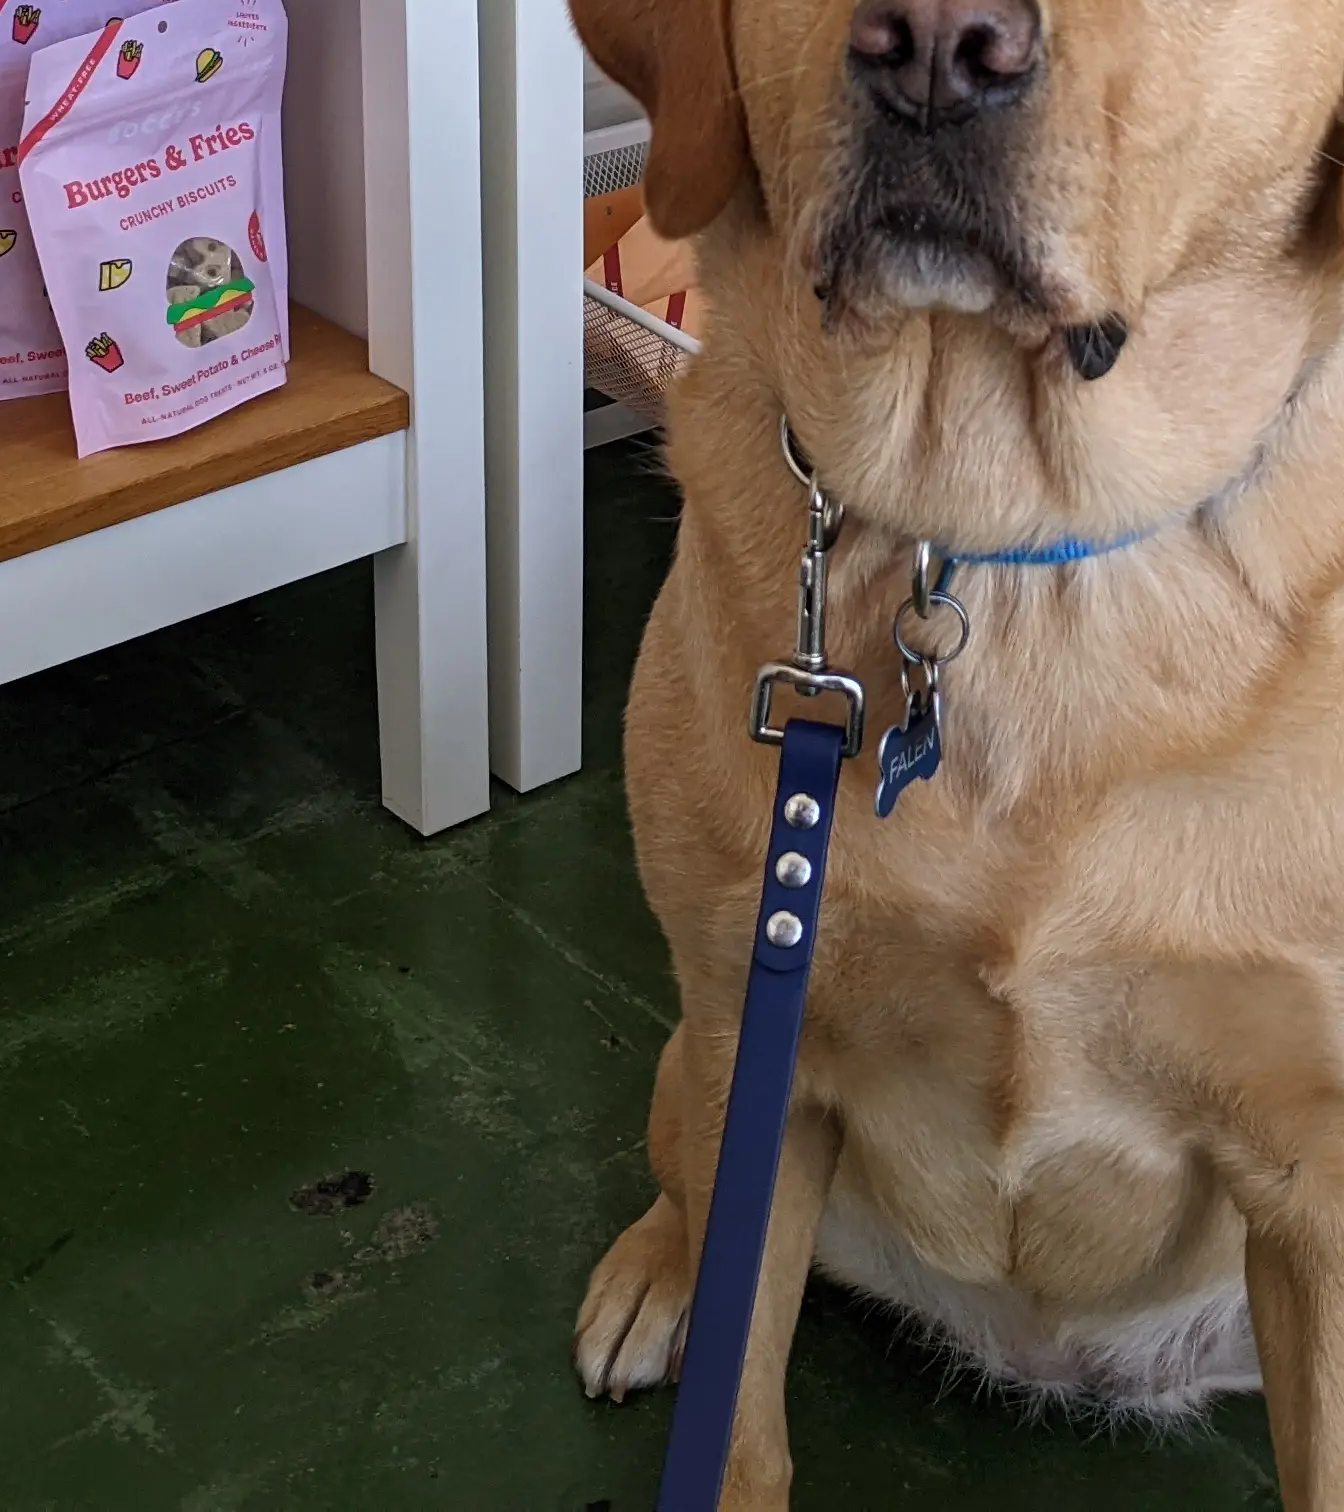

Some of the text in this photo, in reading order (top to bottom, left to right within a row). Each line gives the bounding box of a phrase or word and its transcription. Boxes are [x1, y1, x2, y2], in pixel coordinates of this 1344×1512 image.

[63, 122, 254, 209] Burgers & Fries
[119, 175, 237, 231] CRUNCHY BISCUITS
[124, 360, 229, 406] Beef, Sweet Potato
